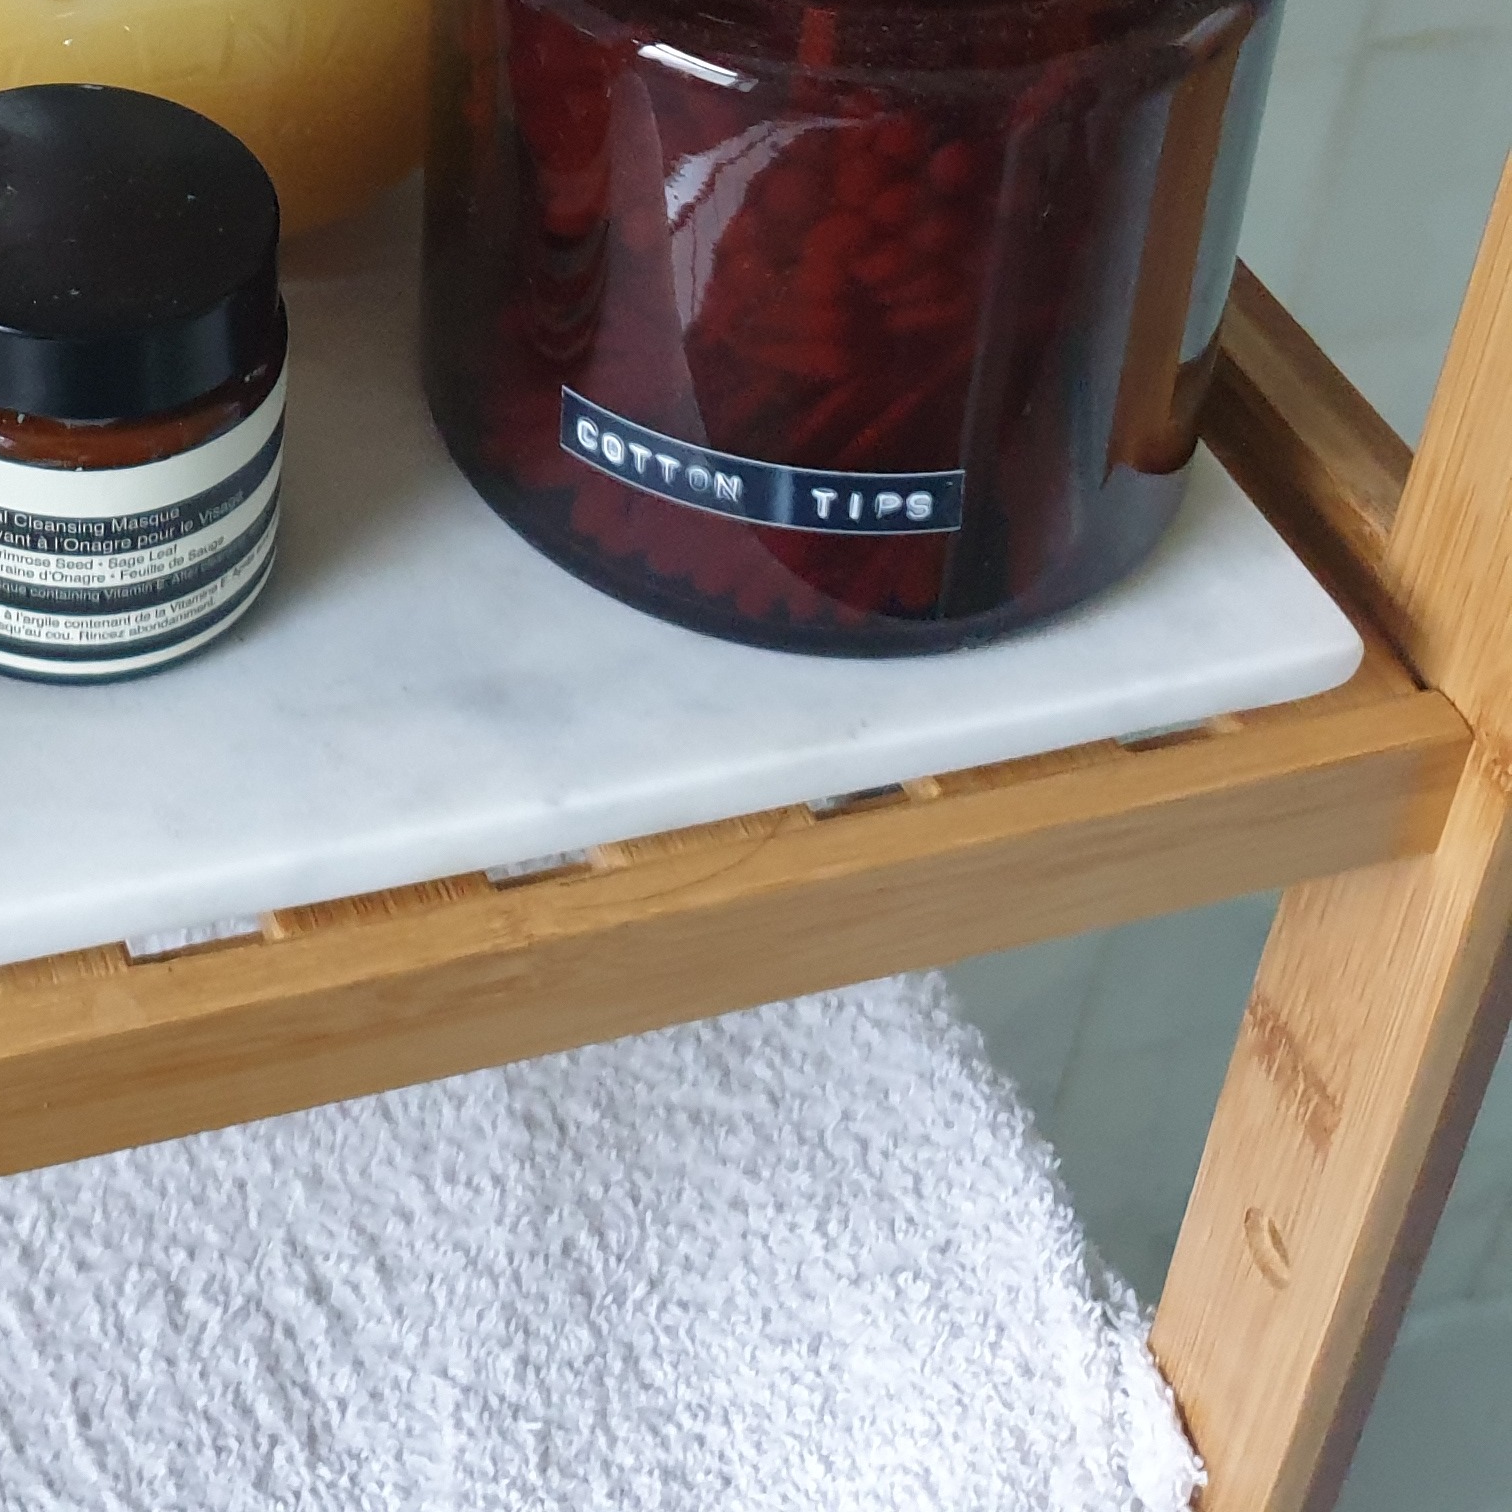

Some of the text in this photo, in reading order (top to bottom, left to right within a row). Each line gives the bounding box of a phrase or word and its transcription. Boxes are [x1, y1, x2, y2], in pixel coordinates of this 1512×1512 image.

[575, 415, 934, 522] COTTON TIPS
[13, 512, 105, 537] Cleansing
[111, 507, 180, 534] Masque
[37, 535, 48, 551] à
[54, 536, 132, 555] l'Onagre
[137, 525, 176, 549] pour
[180, 519, 194, 534] le
[38, 569, 106, 586] d'Onagre
[120, 561, 165, 580] Feuille
[169, 555, 185, 569] de
[55, 557, 94, 571] Seed
[108, 554, 145, 569] Sage
[149, 543, 178, 562] Leaf
[30, 586, 100, 604] containing
[64, 615, 131, 630] contenant
